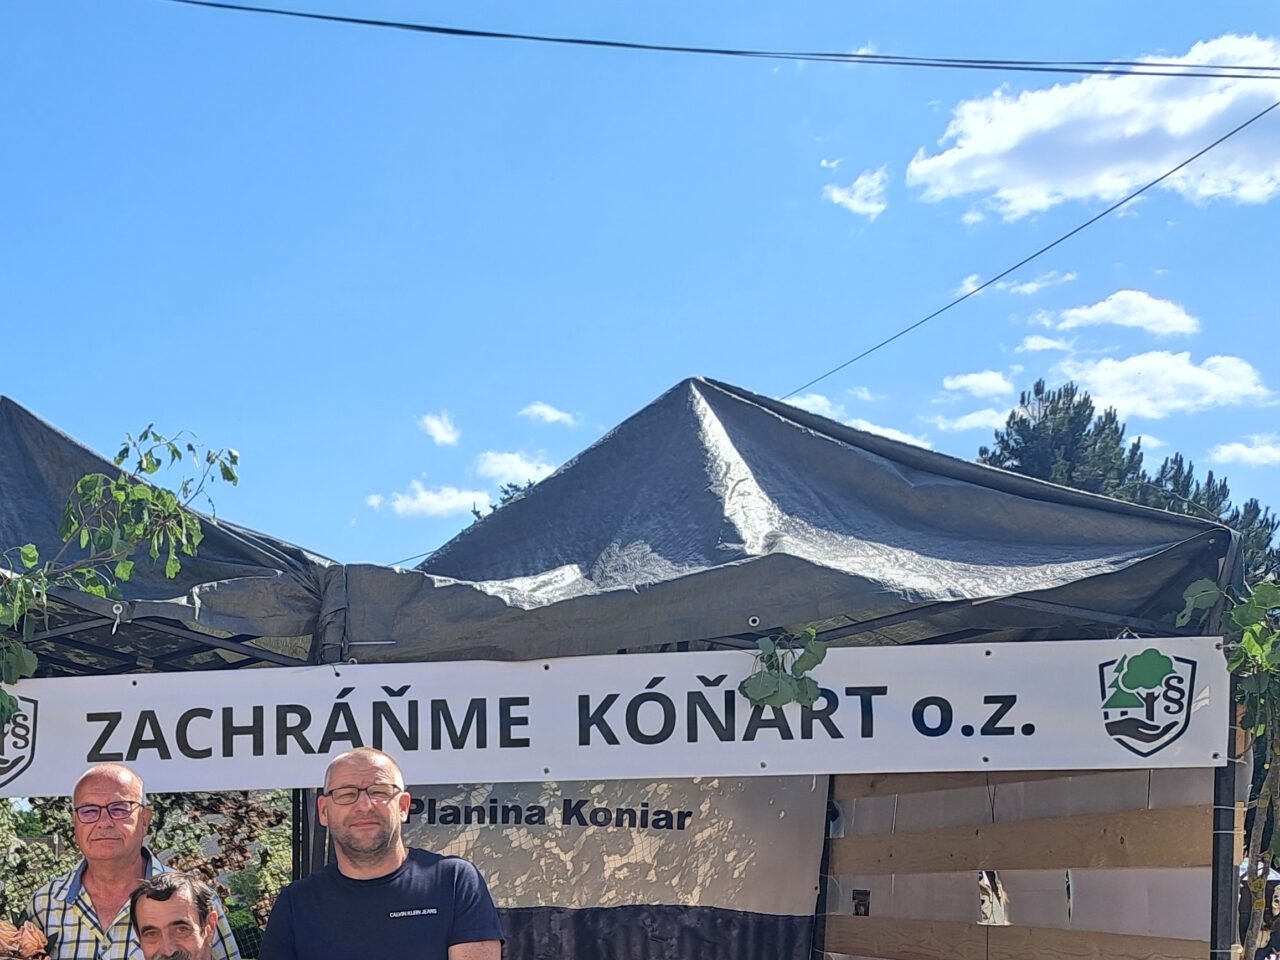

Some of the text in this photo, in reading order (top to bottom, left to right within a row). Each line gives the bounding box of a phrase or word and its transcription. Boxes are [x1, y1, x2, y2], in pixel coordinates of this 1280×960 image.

[85, 684, 531, 763] ZACHRÁŇME
[911, 694, 1036, 738] o.z.
[401, 797, 694, 831] Planina Koniar
